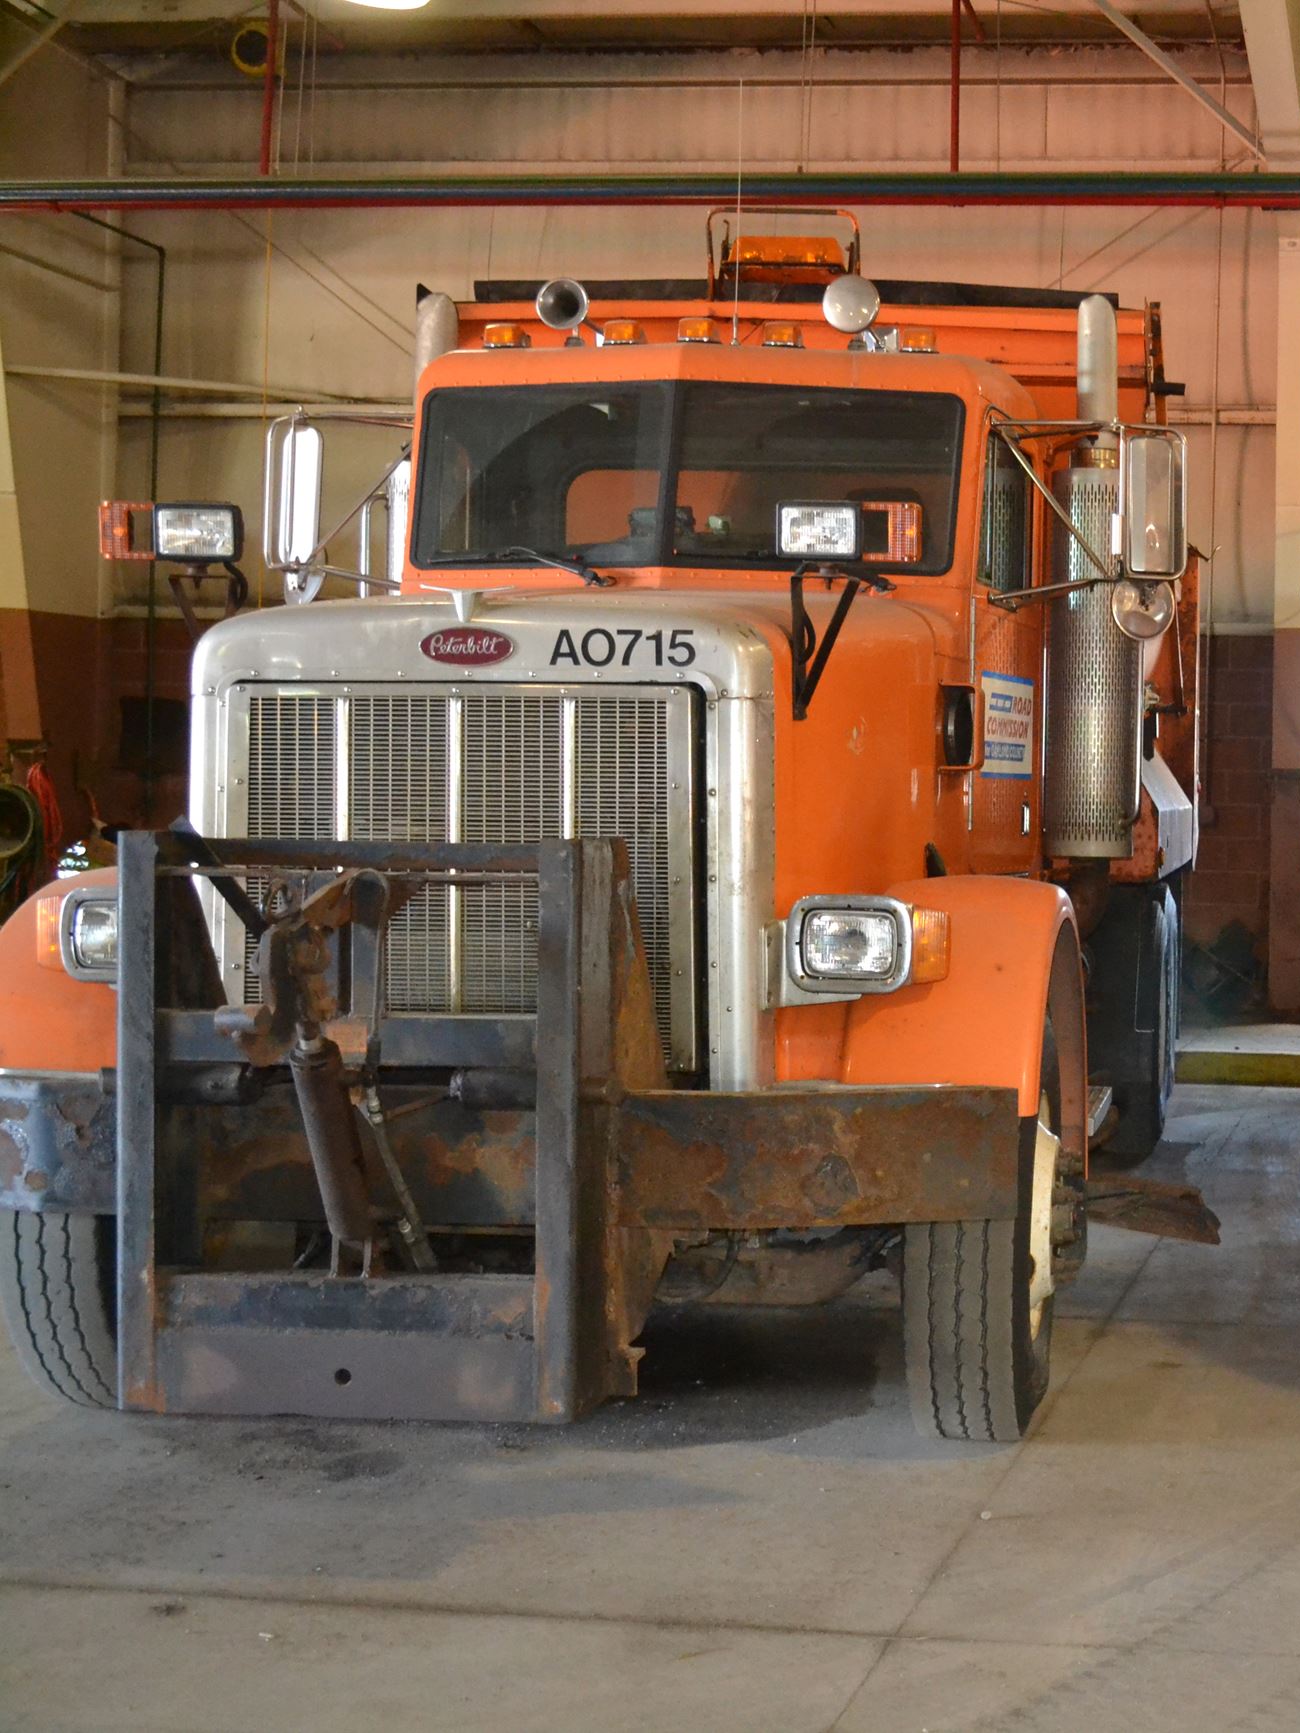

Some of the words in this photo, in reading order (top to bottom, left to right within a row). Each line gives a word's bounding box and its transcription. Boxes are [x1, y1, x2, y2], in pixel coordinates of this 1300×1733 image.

[429, 634, 503, 657] Peterbilt
[1012, 696, 1032, 716] ROAD
[987, 716, 1029, 739] COMMISSION
